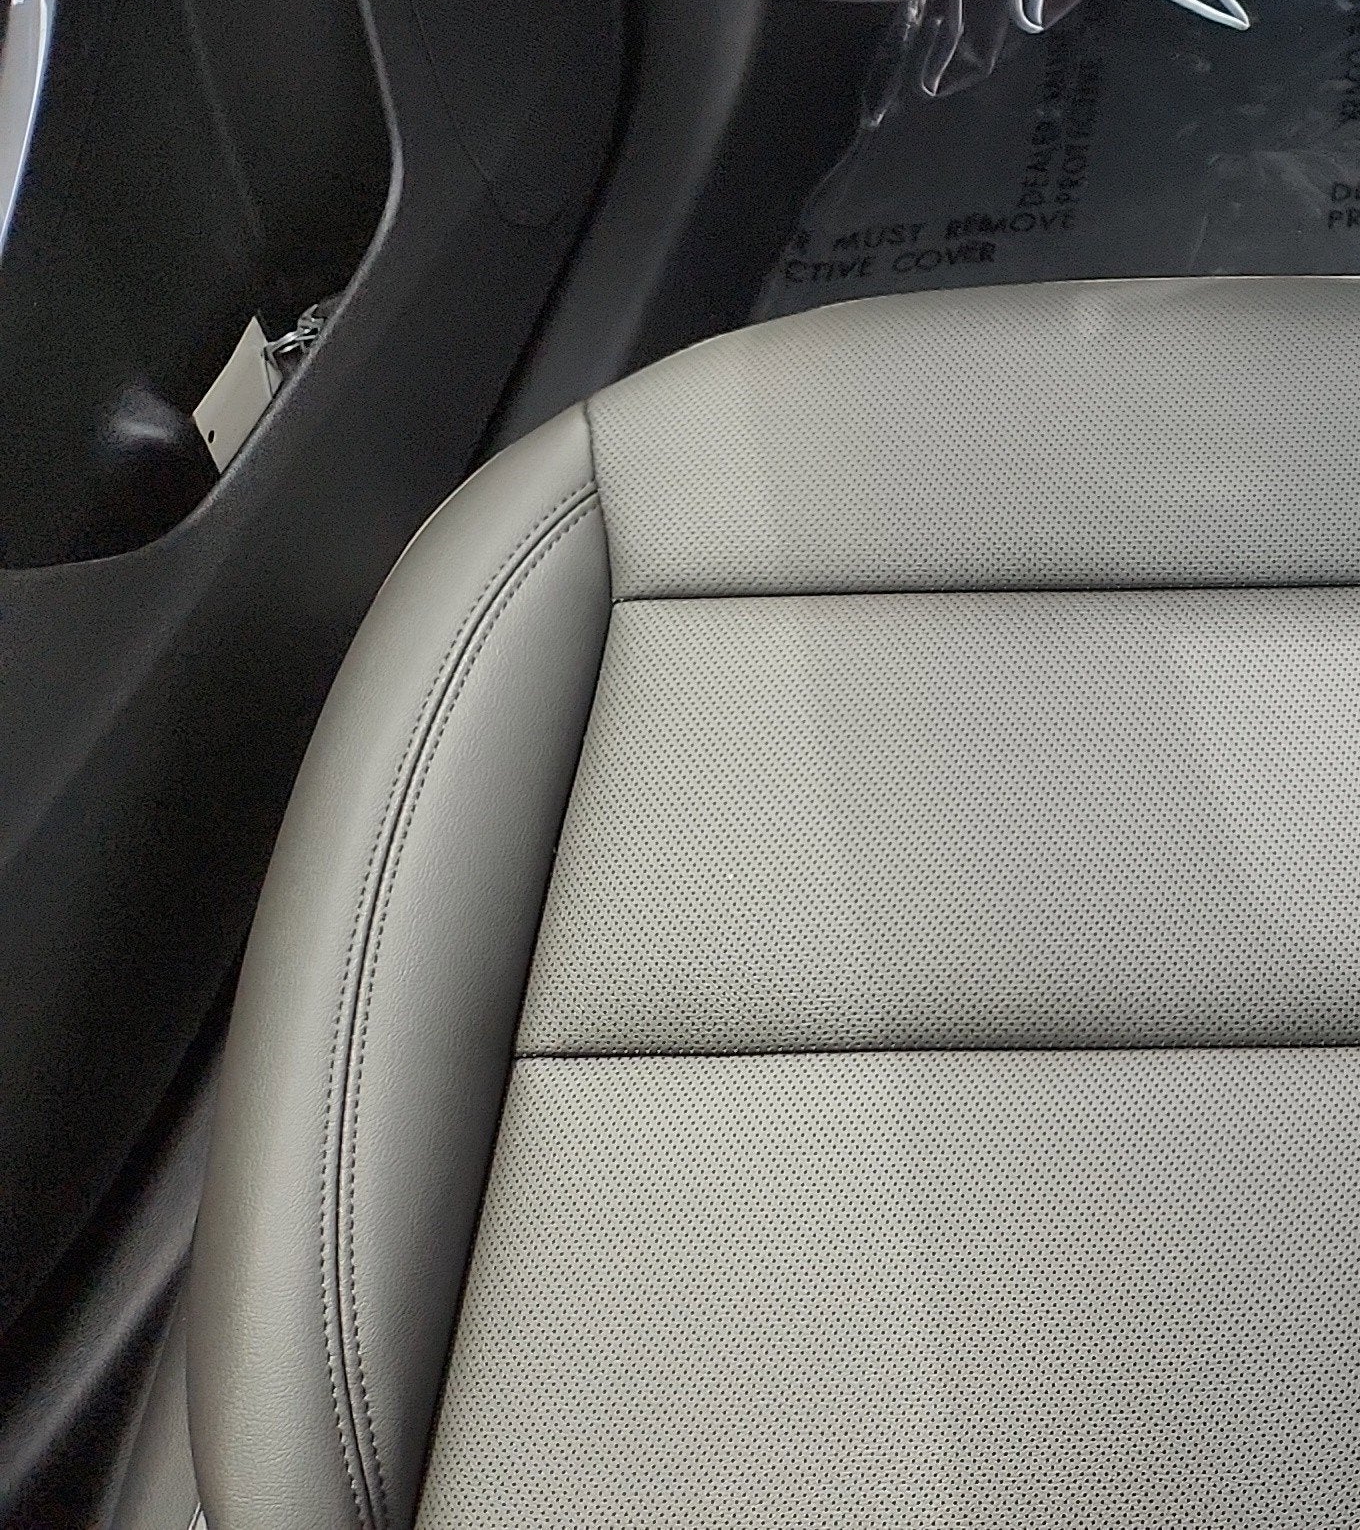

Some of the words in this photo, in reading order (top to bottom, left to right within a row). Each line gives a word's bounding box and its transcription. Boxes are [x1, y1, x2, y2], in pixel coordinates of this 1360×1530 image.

[832, 221, 929, 253] MUST
[944, 206, 1077, 242] REMOVE
[890, 241, 997, 274] COVER
